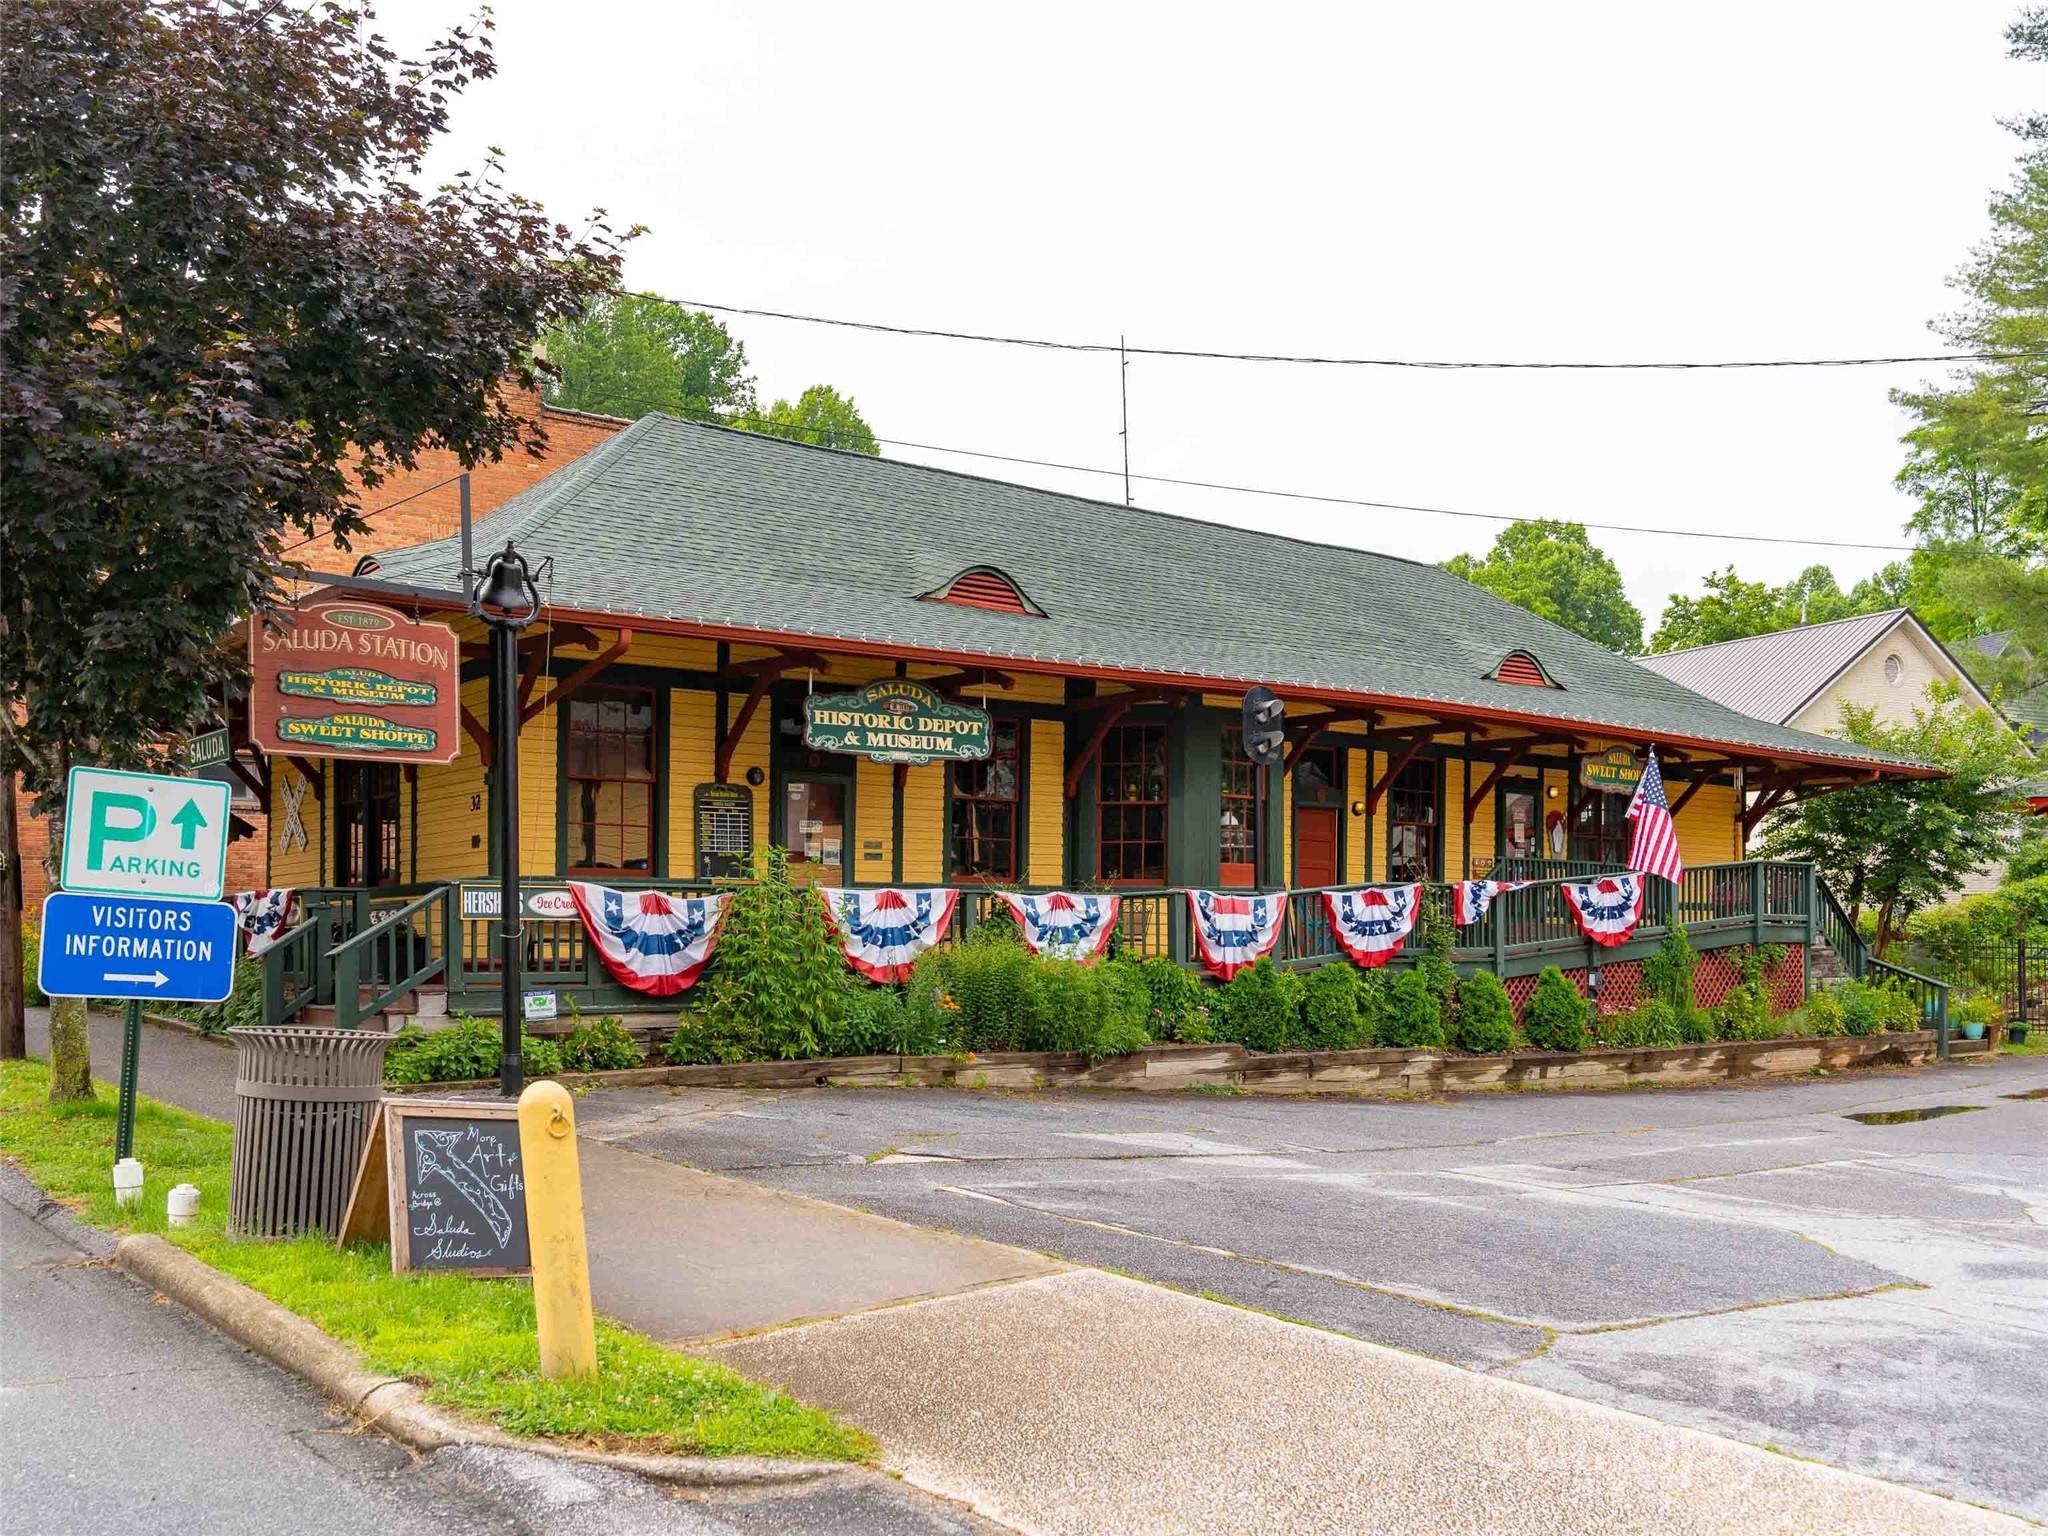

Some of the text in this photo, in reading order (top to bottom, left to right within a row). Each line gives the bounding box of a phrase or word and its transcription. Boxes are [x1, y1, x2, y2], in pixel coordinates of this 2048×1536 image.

[359, 616, 380, 626] 1879
[263, 628, 448, 671] SALUDA STATION
[287, 676, 431, 695] HISTORIC DEPOT
[336, 670, 383, 680] SALUDA
[313, 686, 407, 700] & MUSEUM
[866, 684, 932, 709] SALUDA
[333, 715, 386, 728] SALUDA
[813, 709, 982, 736] HISTORIC DEPOT
[288, 723, 428, 744] SWEET SHOPPE
[843, 731, 953, 752] & MUSEUM
[190, 735, 225, 764] SALUDA
[1586, 764, 1617, 778] SWEET
[470, 794, 481, 812] 32
[537, 896, 552, 909] Ice
[92, 905, 192, 932] VISITORS
[65, 934, 213, 962] INFORMATION
[467, 1127, 496, 1146] More
[467, 1143, 506, 1178] Art
[412, 1190, 436, 1199] Across
[490, 1173, 524, 1200] Gifts
[414, 1213, 476, 1236] Saluda
[425, 1238, 488, 1260] Studios
